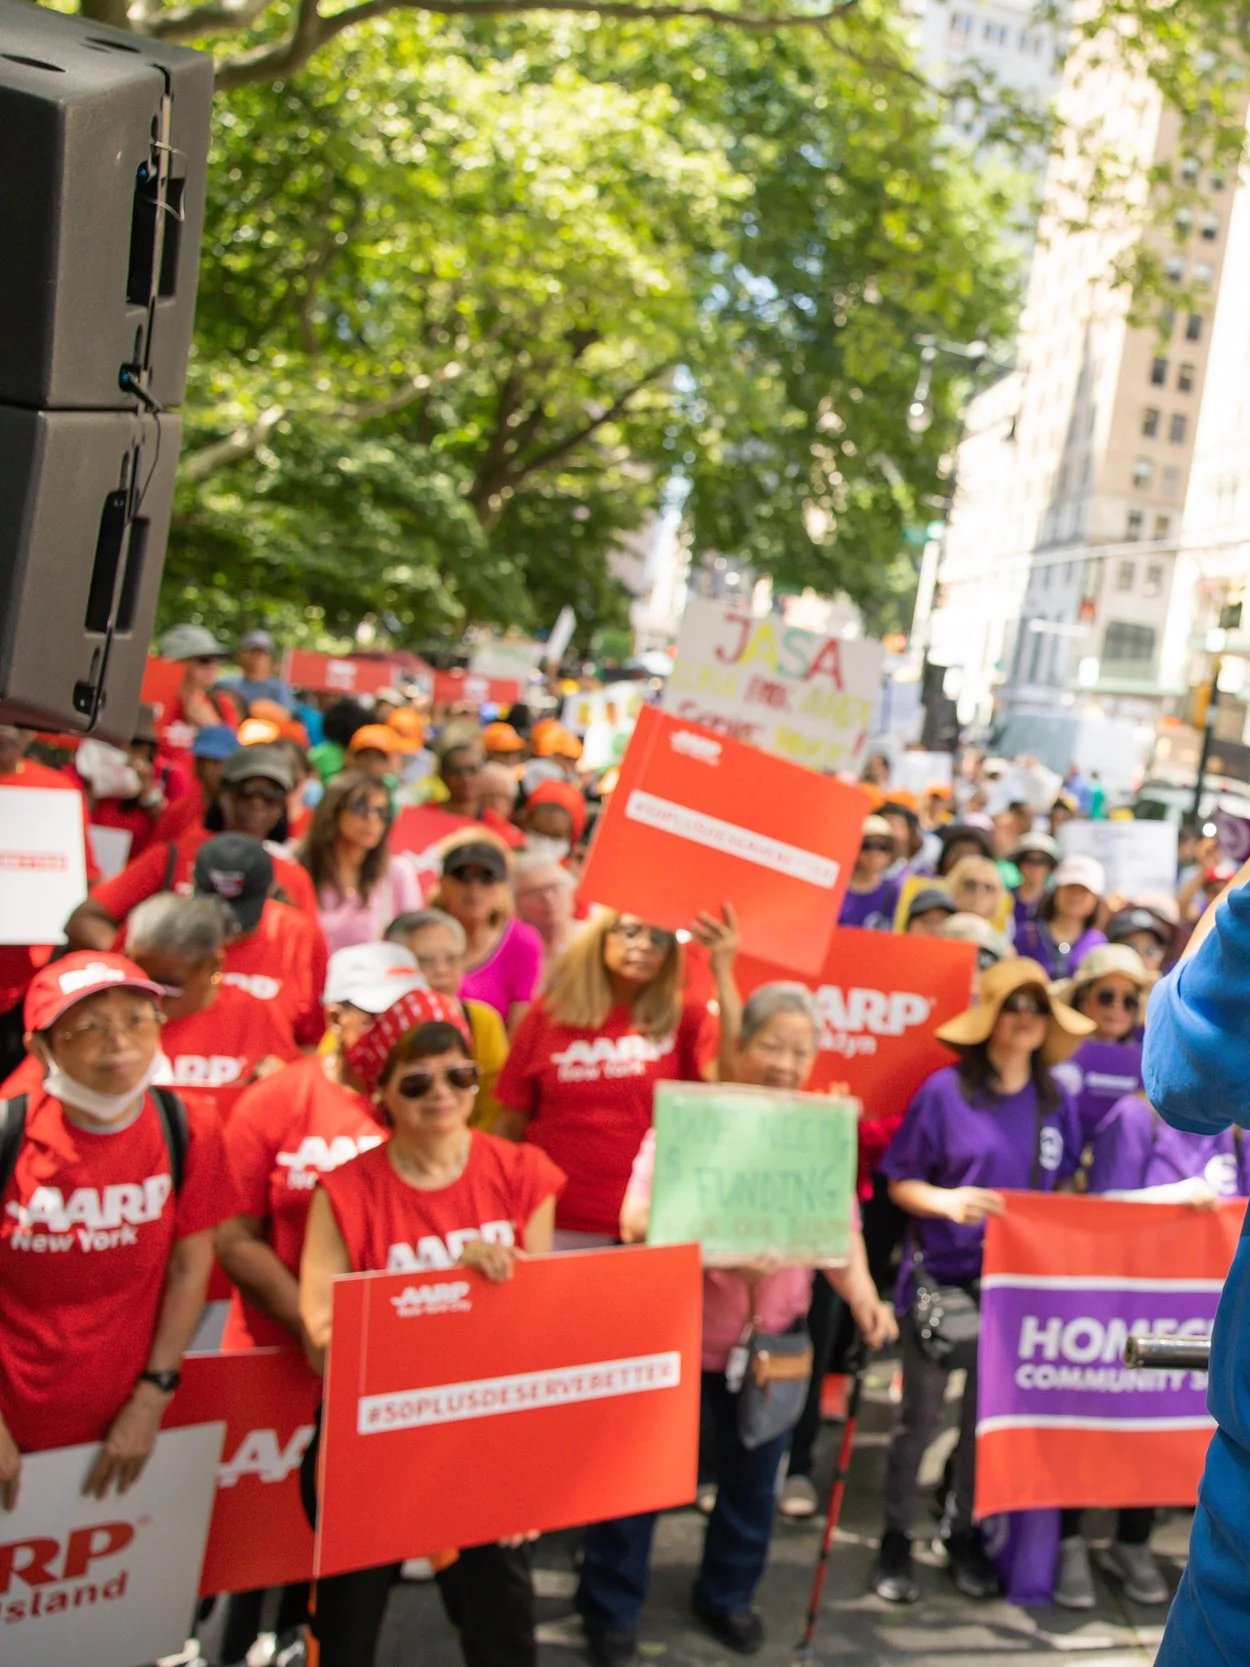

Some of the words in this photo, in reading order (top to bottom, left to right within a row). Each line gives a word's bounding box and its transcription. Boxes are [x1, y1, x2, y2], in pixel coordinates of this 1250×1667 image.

[715, 613, 843, 691] JASA
[5, 1173, 173, 1232] AARP
[11, 1230, 74, 1253] New
[78, 1222, 139, 1253] York
[1015, 1363, 1188, 1393] COMMUNITY
